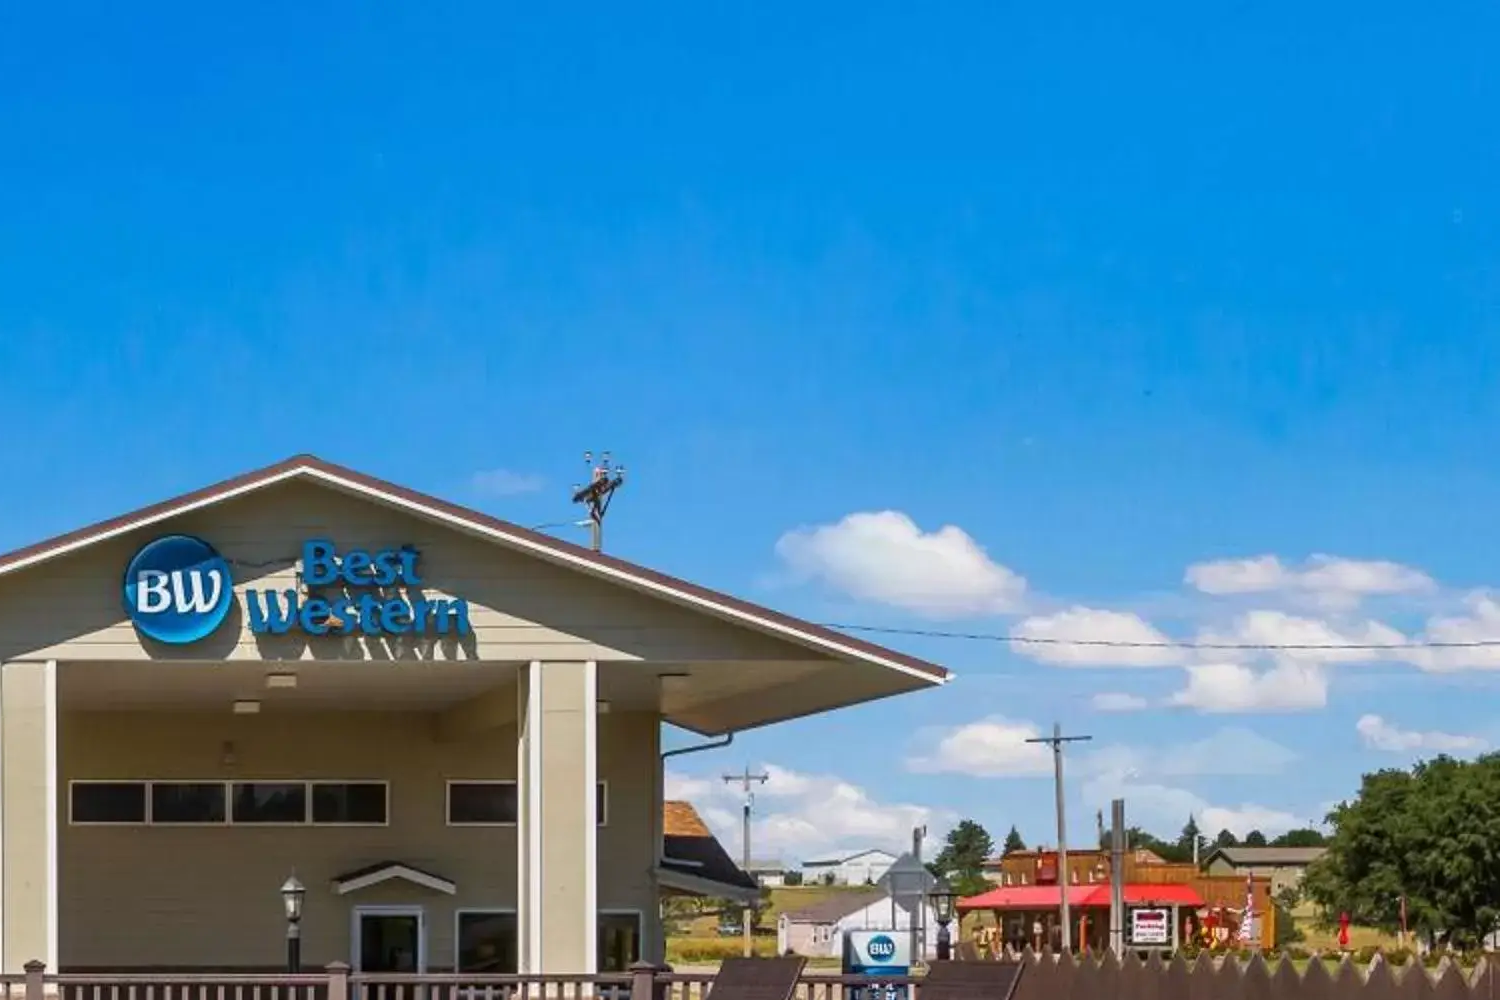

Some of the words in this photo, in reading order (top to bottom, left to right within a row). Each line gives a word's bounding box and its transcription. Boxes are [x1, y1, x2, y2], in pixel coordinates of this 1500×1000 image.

[303, 537, 421, 586] Best
[136, 568, 222, 614] BW
[246, 588, 471, 636] Western
[869, 943, 893, 957] BW
